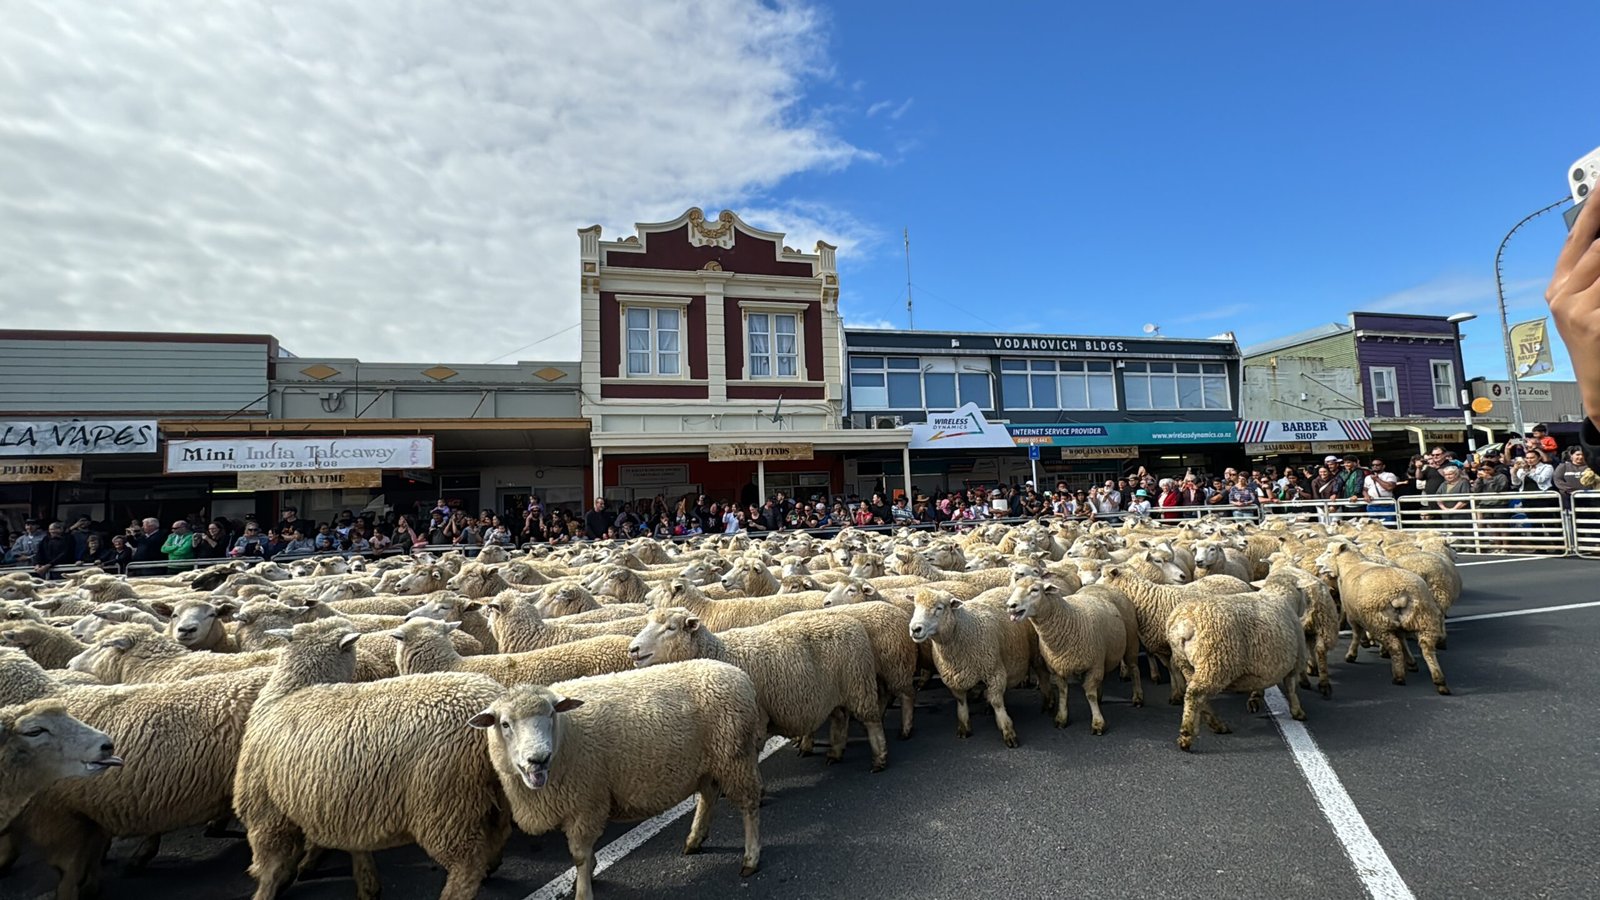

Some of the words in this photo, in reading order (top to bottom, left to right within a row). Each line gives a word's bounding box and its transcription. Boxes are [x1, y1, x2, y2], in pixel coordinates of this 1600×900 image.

[994, 338, 1077, 350] VODANOVICH
[1085, 341, 1128, 352] BLDGS.
[1529, 387, 1549, 396] Zone
[1012, 427, 1043, 435] INTERNET
[1045, 427, 1070, 435] SERVICE
[1071, 427, 1101, 435] PROVIDER
[1281, 422, 1328, 431] BARBER
[51, 425, 152, 447] VAPES
[1152, 431, 1231, 440] www.wirelessdynamics.co.nz
[183, 447, 233, 461] Mini
[247, 442, 294, 460] India
[305, 441, 397, 464] Takeaway
[735, 448, 763, 456] FLEECY
[766, 447, 790, 455] FINDS
[3, 465, 54, 475] PLUMES
[278, 475, 316, 484] TUCKA
[319, 474, 345, 483] TIME
